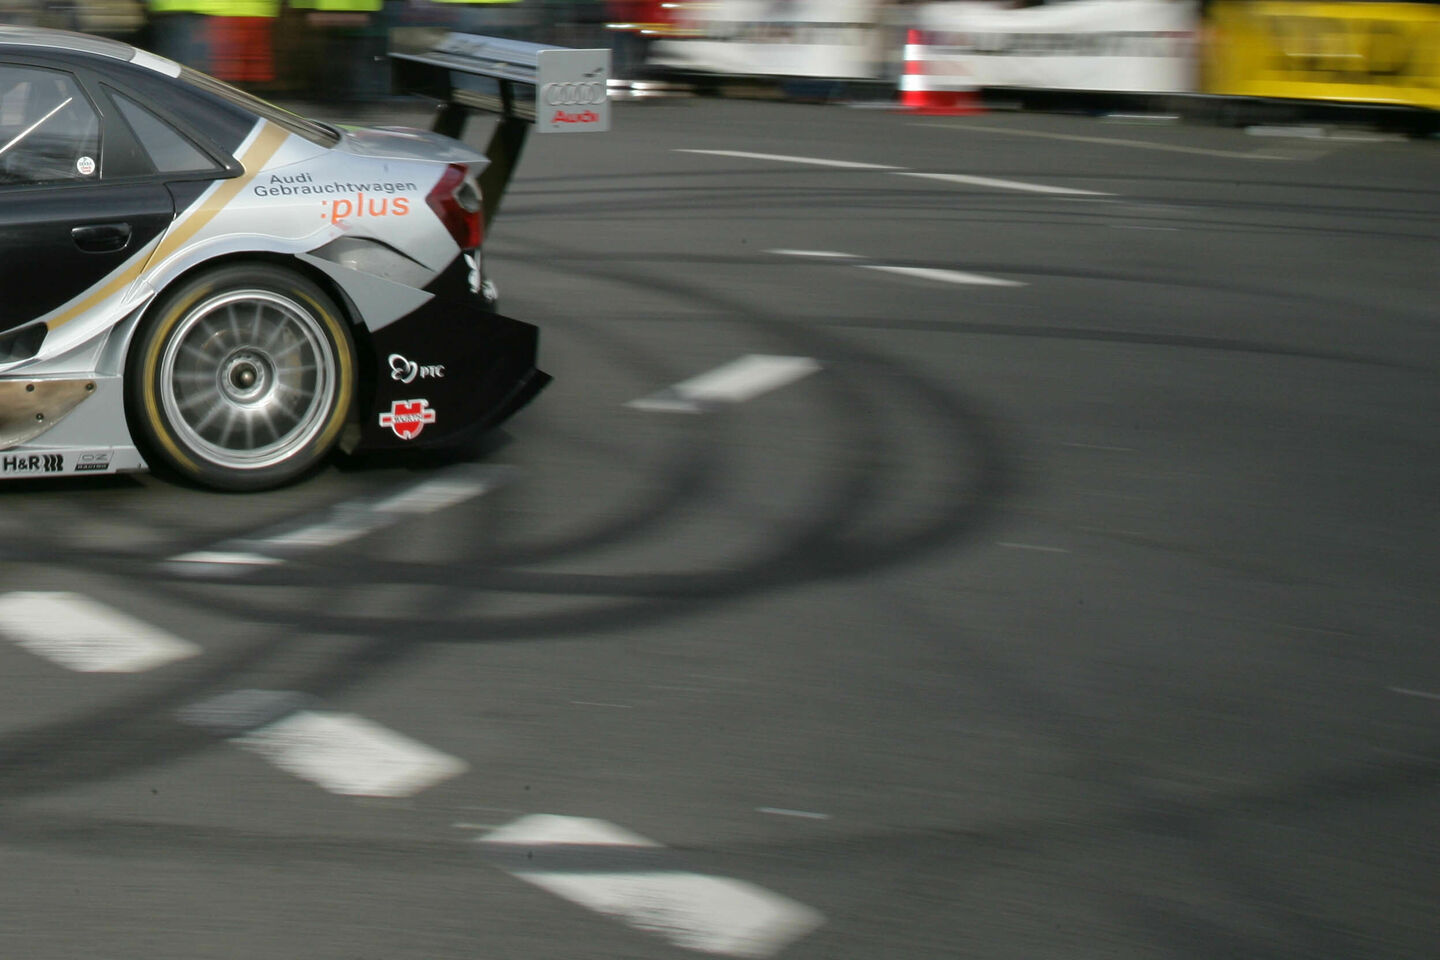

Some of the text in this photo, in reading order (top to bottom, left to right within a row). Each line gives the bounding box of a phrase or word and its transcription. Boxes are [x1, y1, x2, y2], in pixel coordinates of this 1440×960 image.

[551, 110, 599, 123] Audi
[270, 172, 312, 184] Audi
[254, 181, 417, 197] Gebrauchtwagen
[3, 455, 40, 471] H&R
